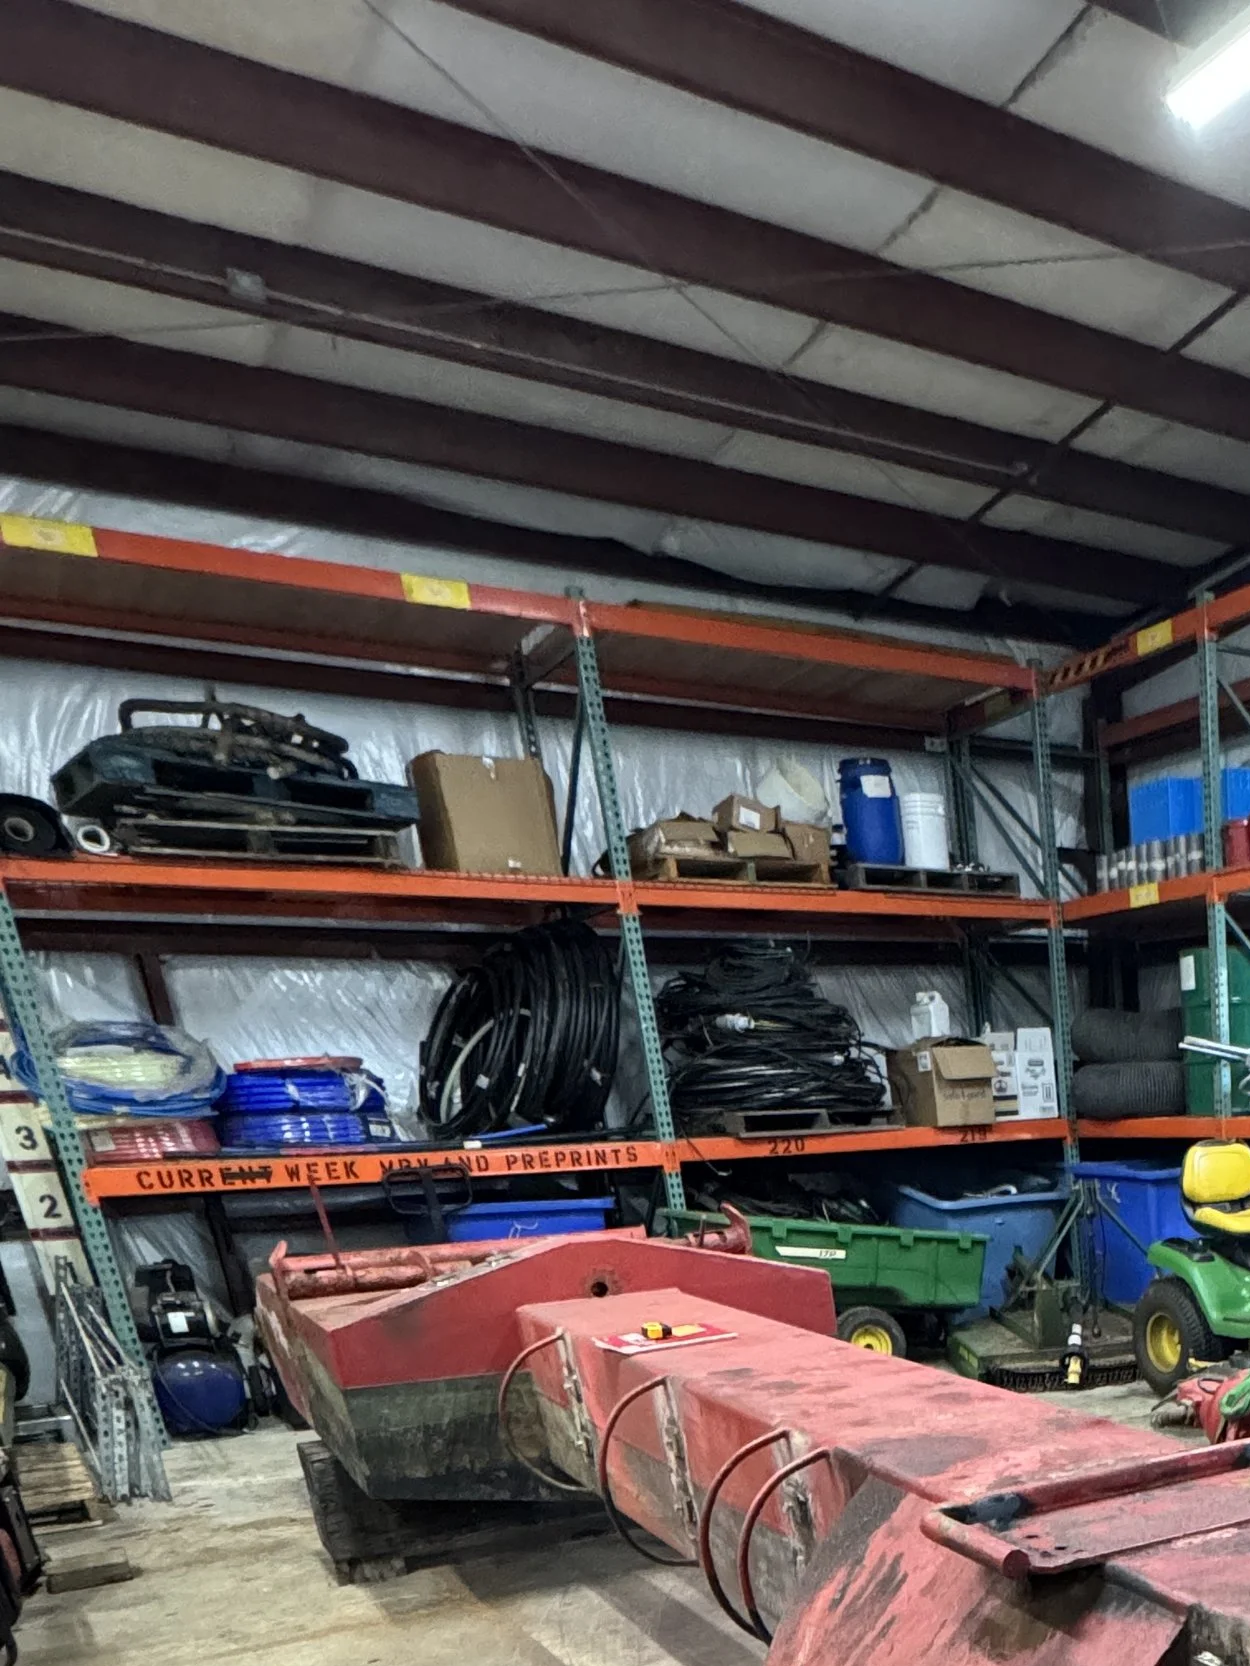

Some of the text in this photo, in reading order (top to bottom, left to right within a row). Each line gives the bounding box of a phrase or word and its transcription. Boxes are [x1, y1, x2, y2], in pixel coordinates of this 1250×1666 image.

[15, 1125, 38, 1150] 3
[768, 1138, 806, 1155] 220
[285, 1160, 360, 1183] WEEK
[506, 1146, 639, 1171] PREPRINTS
[39, 1194, 62, 1218] 2
